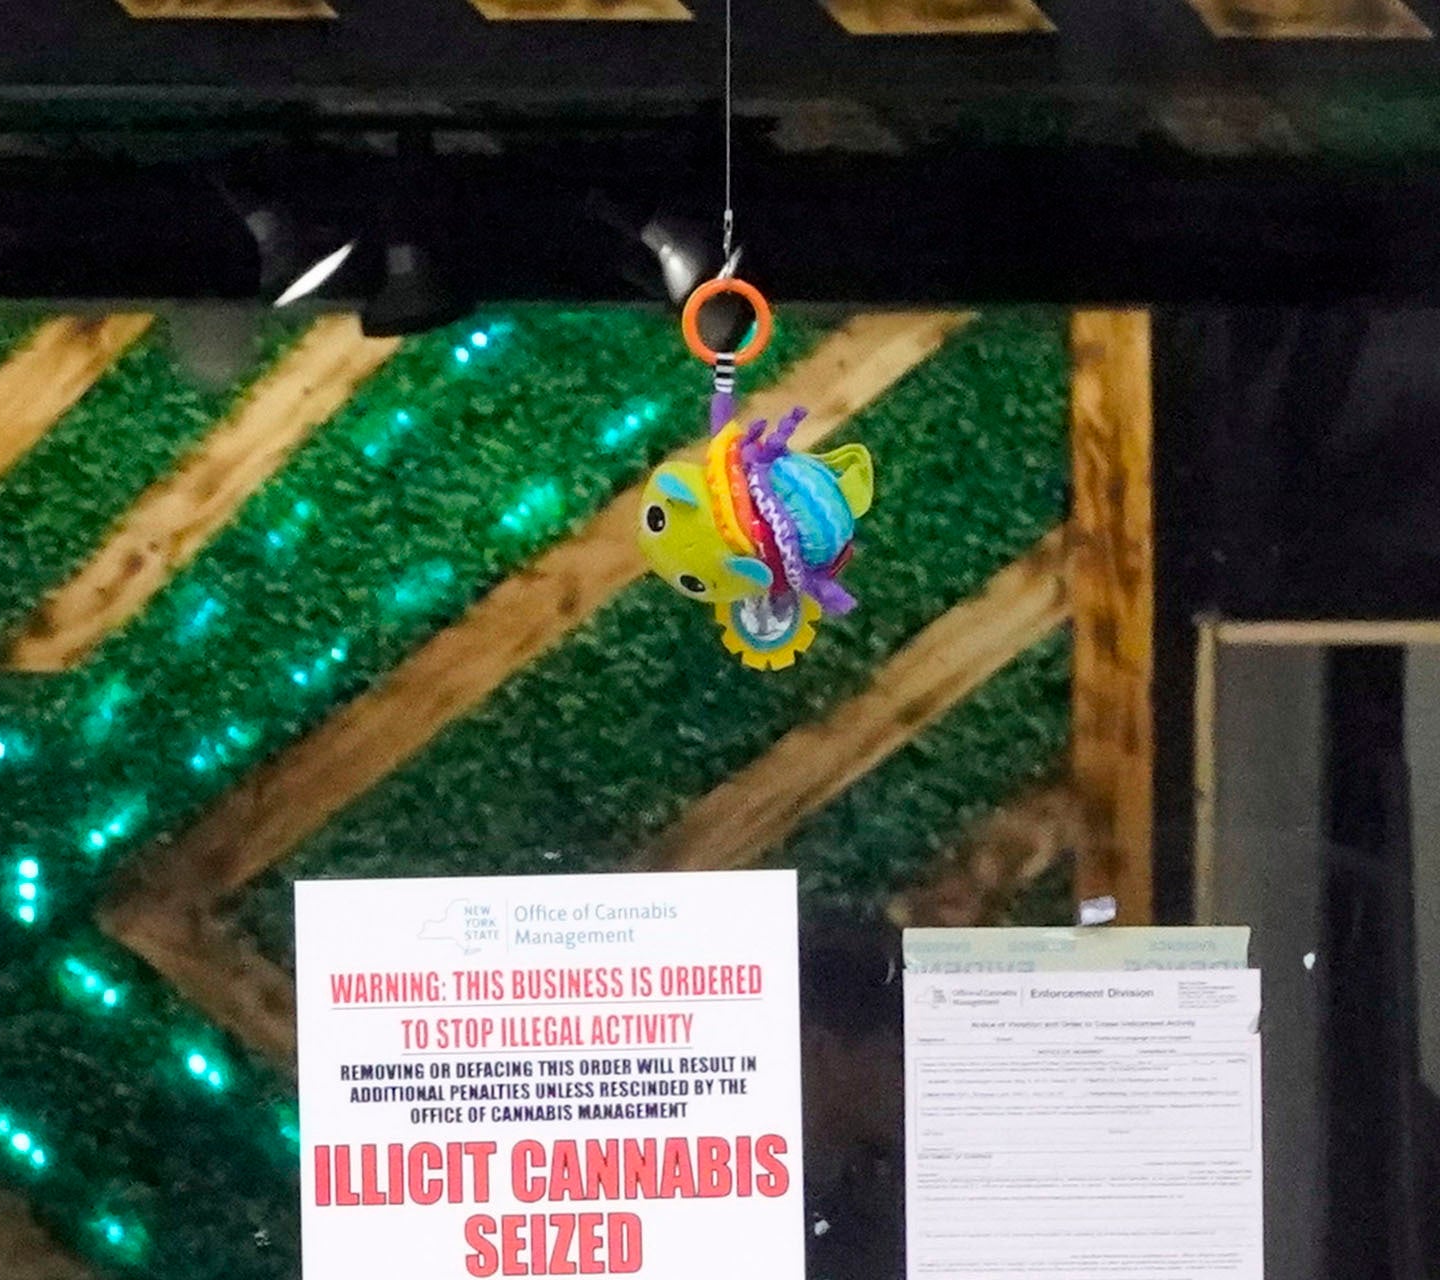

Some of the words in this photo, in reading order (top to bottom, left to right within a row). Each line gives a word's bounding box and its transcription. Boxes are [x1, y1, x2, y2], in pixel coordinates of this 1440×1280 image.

[463, 905, 490, 916] NEW
[464, 917, 497, 928] YORK
[513, 903, 567, 922] Office
[572, 903, 589, 920] of
[592, 901, 677, 920] Cannabis
[464, 929, 499, 940] STATE
[514, 925, 634, 950] Management
[330, 970, 446, 1004] WARNING:
[452, 969, 504, 1001] THIS
[511, 966, 623, 1000] BUSINESS
[631, 966, 652, 997] IS
[659, 964, 762, 997] ORDERED
[1030, 988, 1104, 999] Enforcement
[1107, 987, 1154, 999] Division
[400, 1018, 429, 1049] TO
[436, 1017, 494, 1049] STOP
[500, 1015, 584, 1047] ILLEGAL
[590, 1012, 694, 1045] ACTIVITY
[340, 1062, 424, 1081] REMOVING
[429, 1062, 450, 1079] OR
[455, 1060, 533, 1078] DEFACING
[537, 1059, 574, 1076] THIS
[579, 1058, 631, 1076] ORDER
[636, 1057, 674, 1074] WILL
[679, 1056, 735, 1073] RESULT
[741, 1056, 756, 1071] IN
[349, 1085, 445, 1103] ADDITIONAL
[449, 1082, 530, 1101] PENALTIES
[535, 1081, 594, 1099] UNLESS
[599, 1079, 689, 1097] RESCINDED
[694, 1078, 714, 1095] BY
[718, 1078, 746, 1095] THE
[410, 1106, 462, 1124] OFFICE
[467, 1106, 486, 1123] OF
[491, 1104, 572, 1122] CANNABIS
[577, 1101, 688, 1120] MANAGEMENT
[313, 1139, 498, 1208] ILLICIT
[510, 1133, 790, 1203] CANNABIS
[463, 1210, 643, 1278] SEIZED
